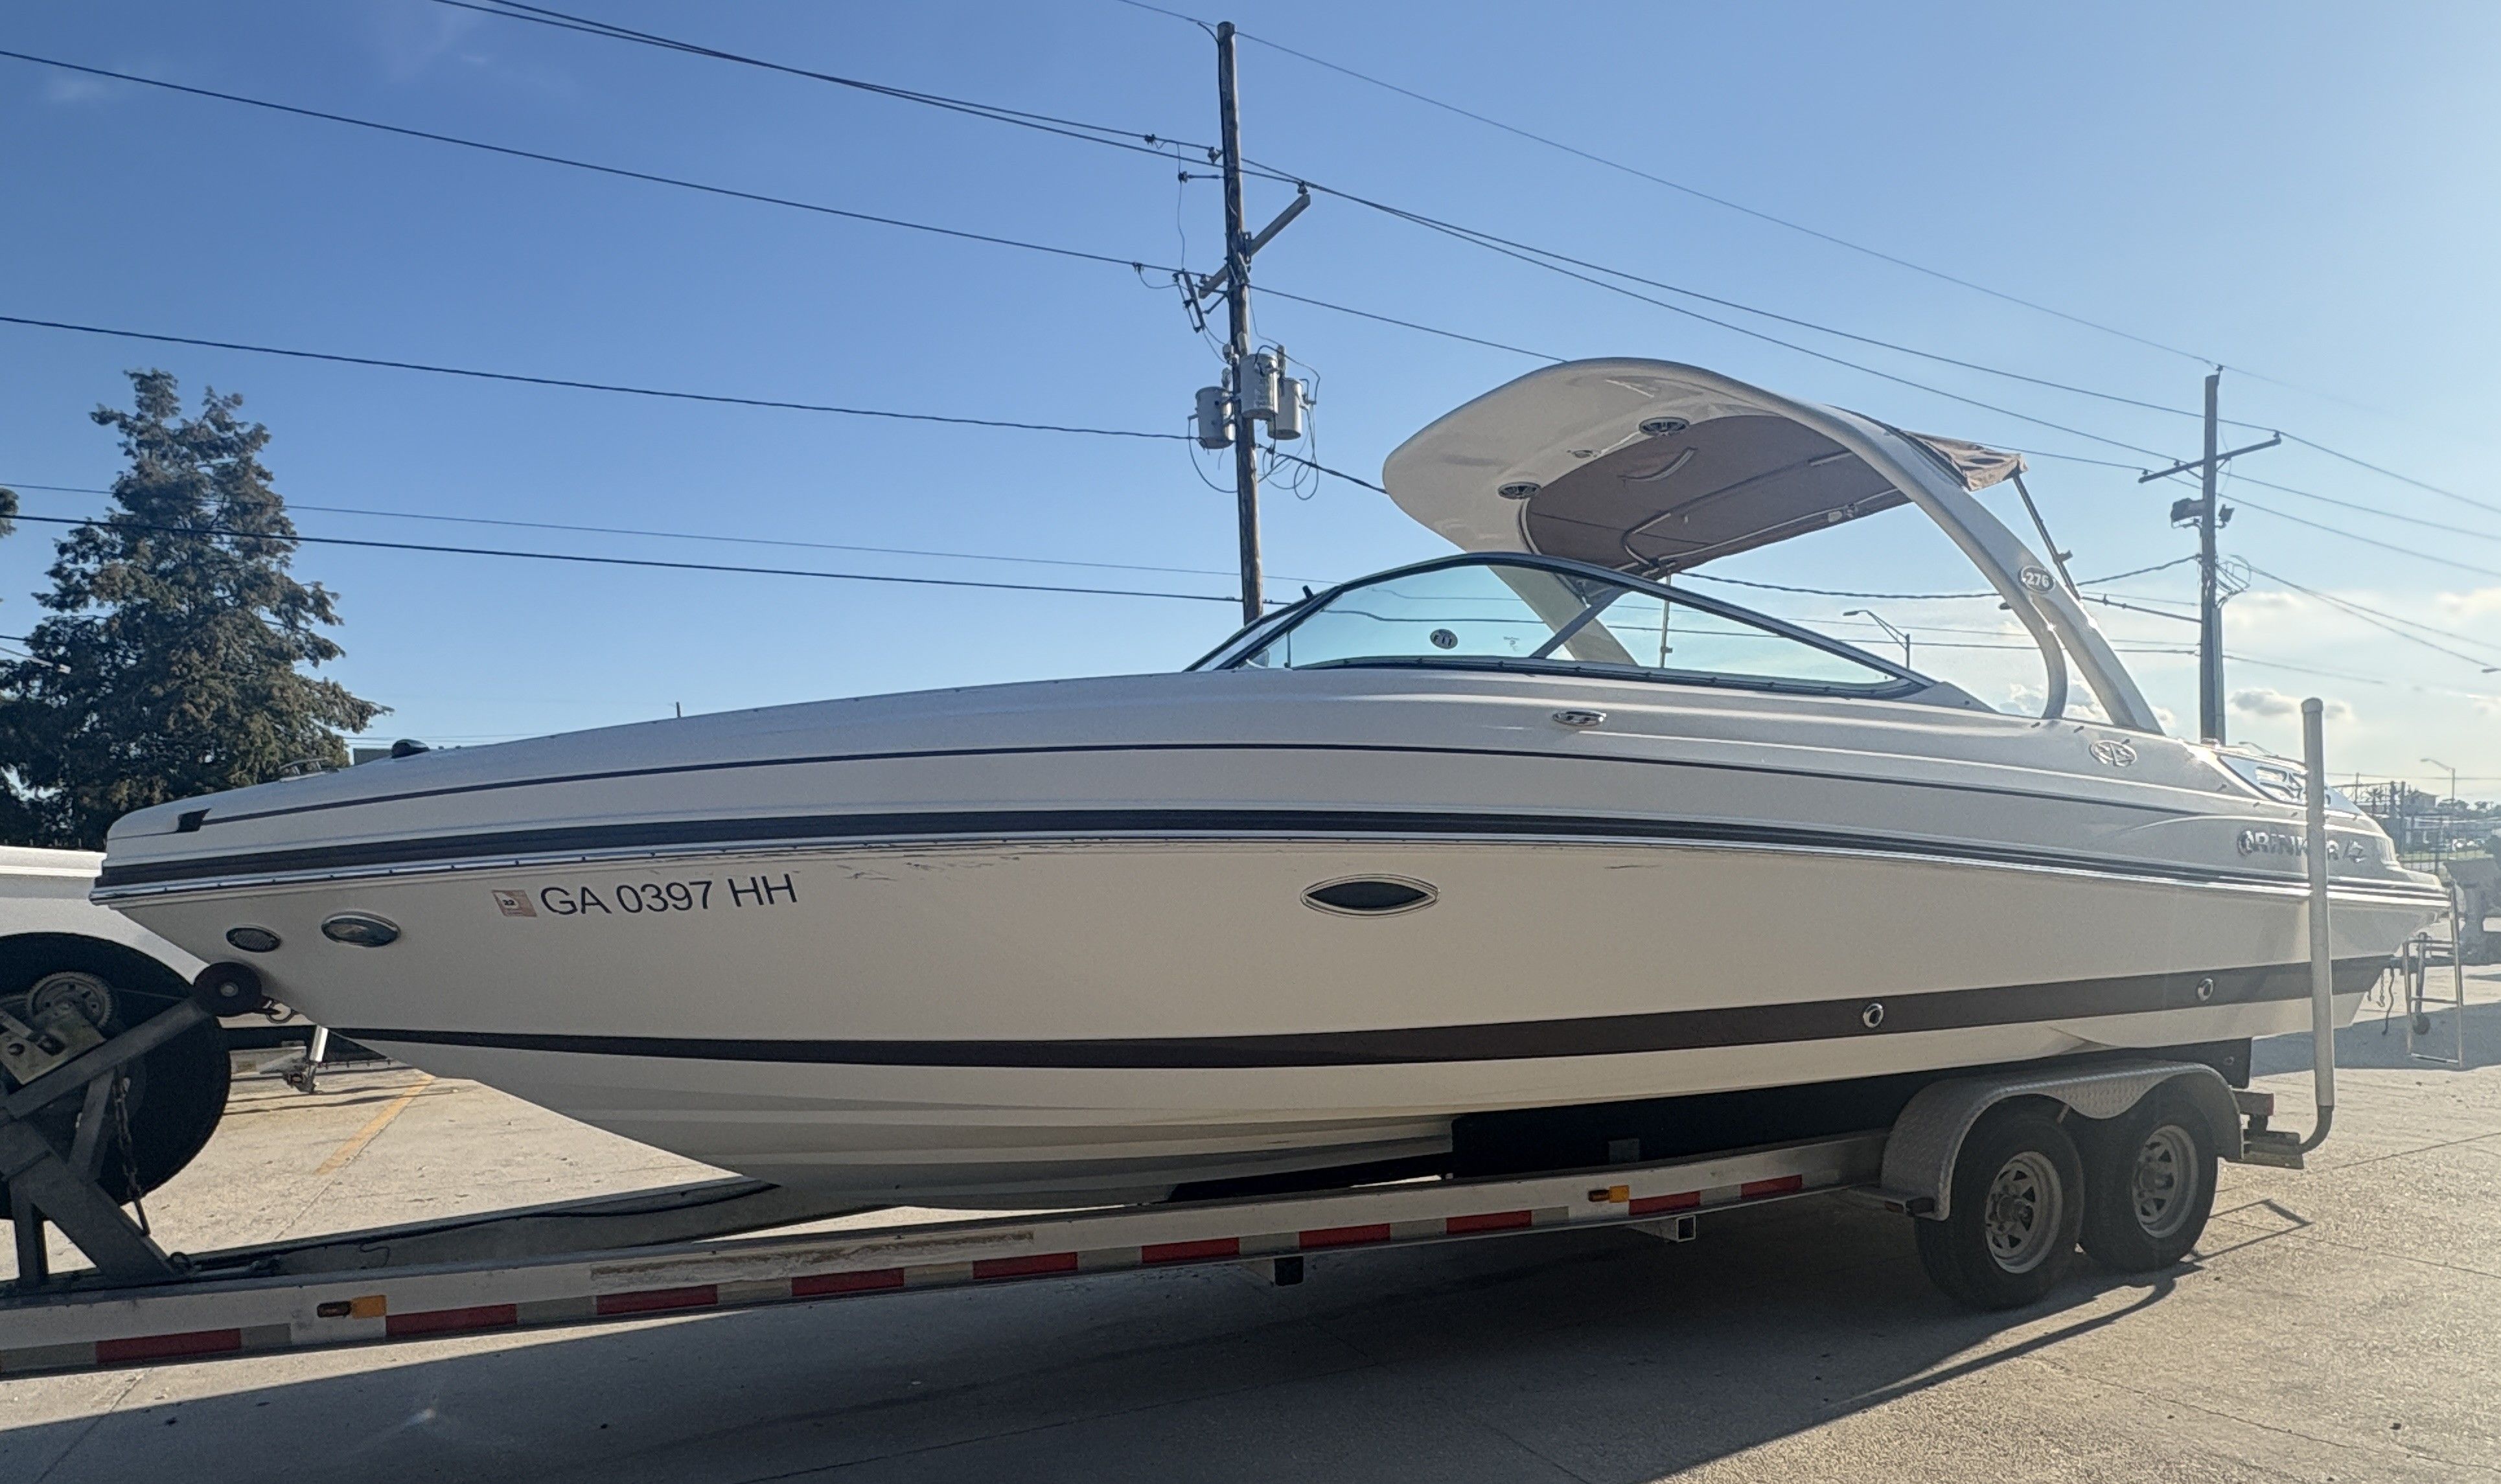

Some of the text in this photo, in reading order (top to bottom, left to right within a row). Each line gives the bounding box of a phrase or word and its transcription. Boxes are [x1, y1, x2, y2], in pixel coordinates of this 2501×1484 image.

[2025, 572, 2049, 588] 276
[2254, 831, 2339, 860] RINKR
[540, 874, 797, 915] GA 0397 HH
